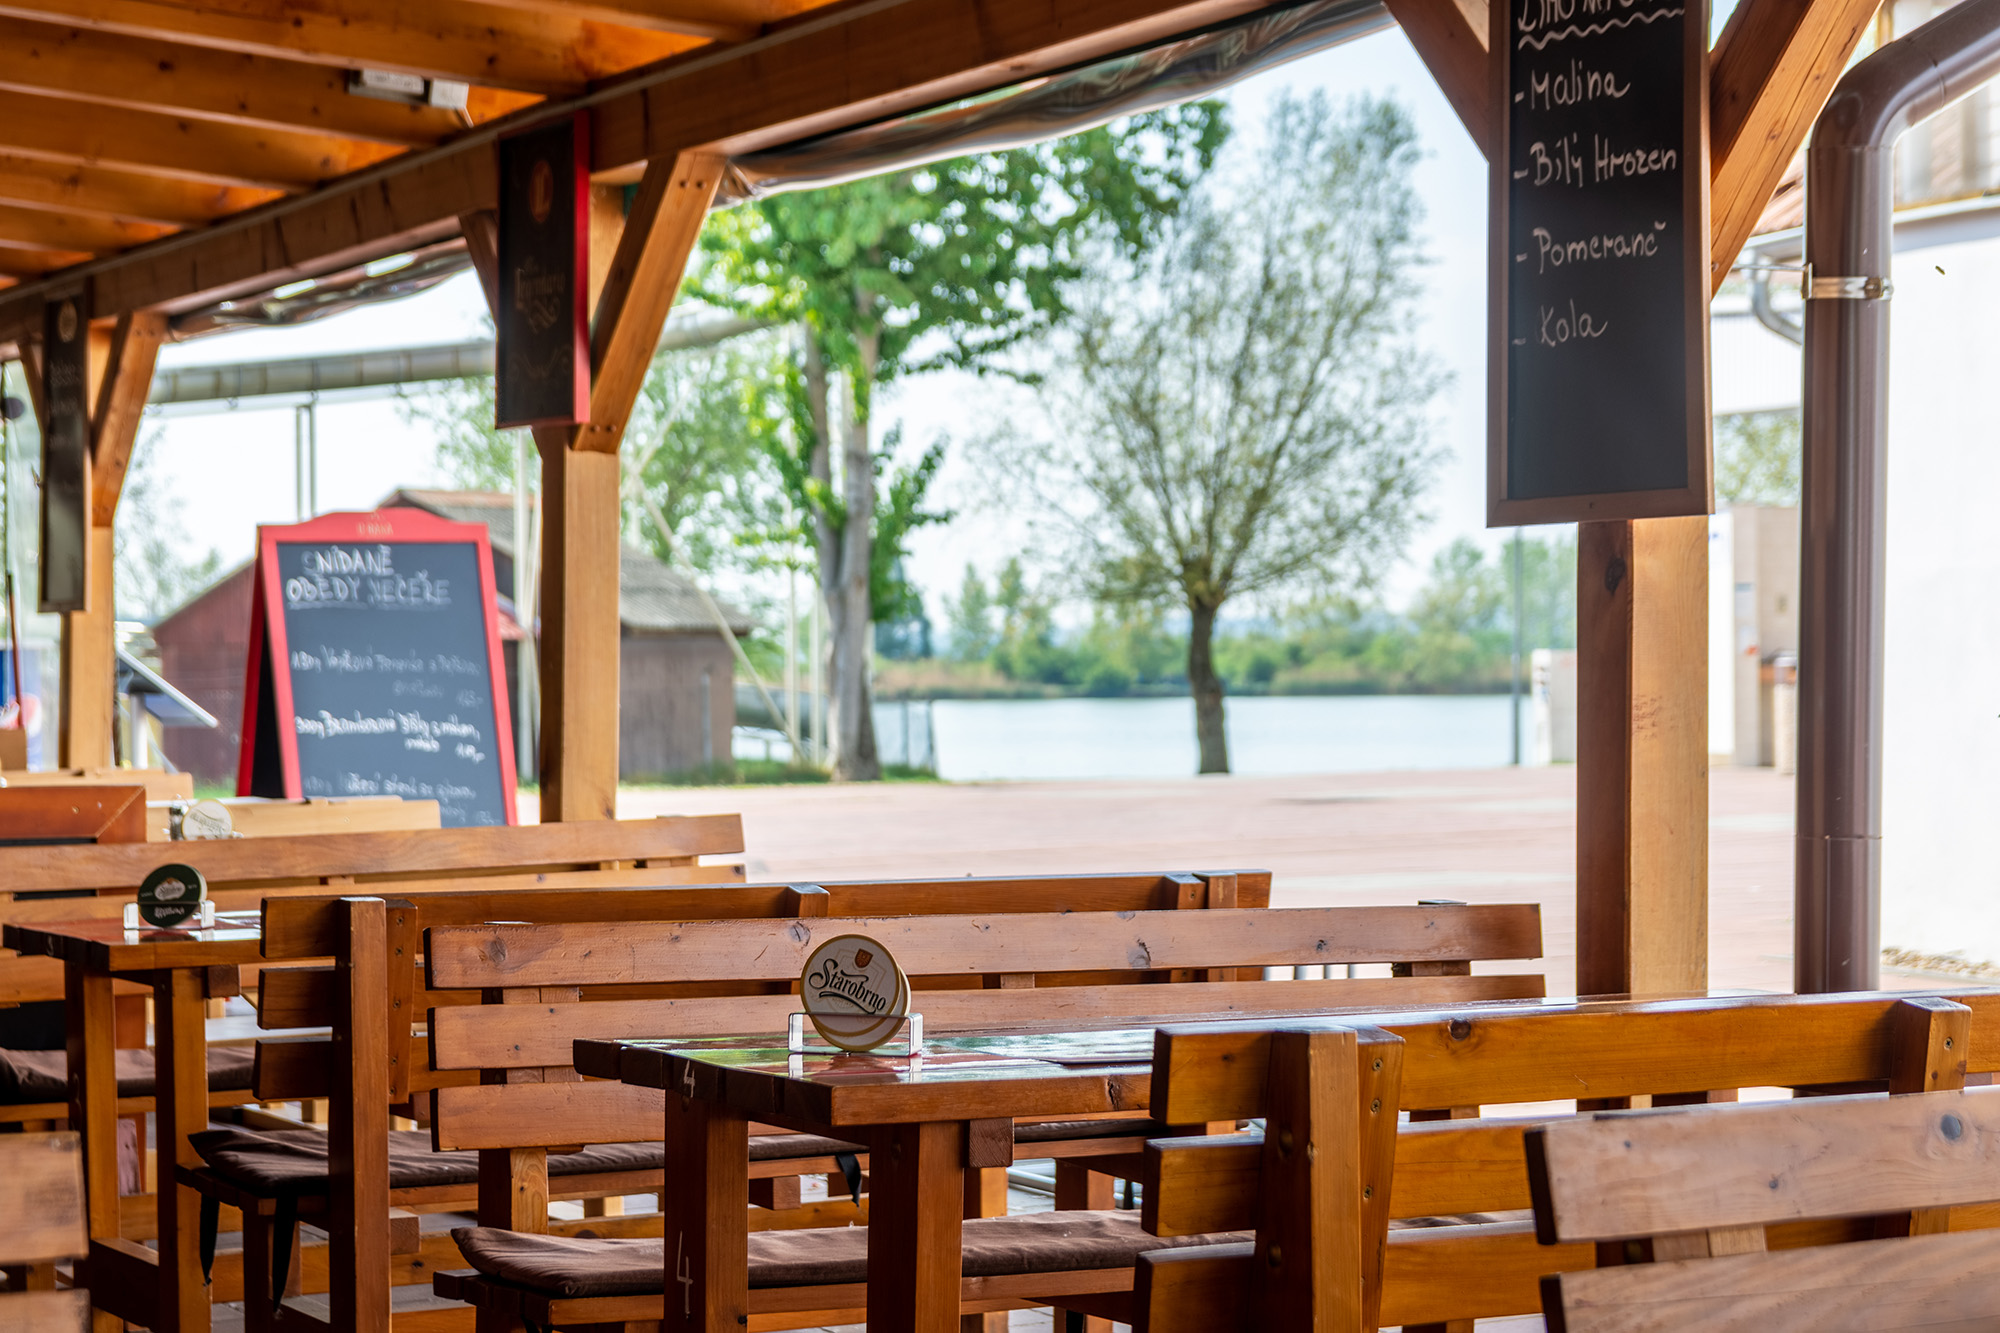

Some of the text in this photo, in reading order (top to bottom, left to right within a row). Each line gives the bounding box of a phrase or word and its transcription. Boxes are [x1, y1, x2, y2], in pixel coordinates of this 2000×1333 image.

[1530, 58, 1632, 110] Malina
[1594, 133, 1677, 183] Hrozen
[1532, 220, 1667, 274] Pomeranč
[1539, 298, 1609, 347] Kola
[808, 958, 887, 1013] Starobrno
[683, 1059, 696, 1098] 4
[676, 1230, 694, 1318] 4
